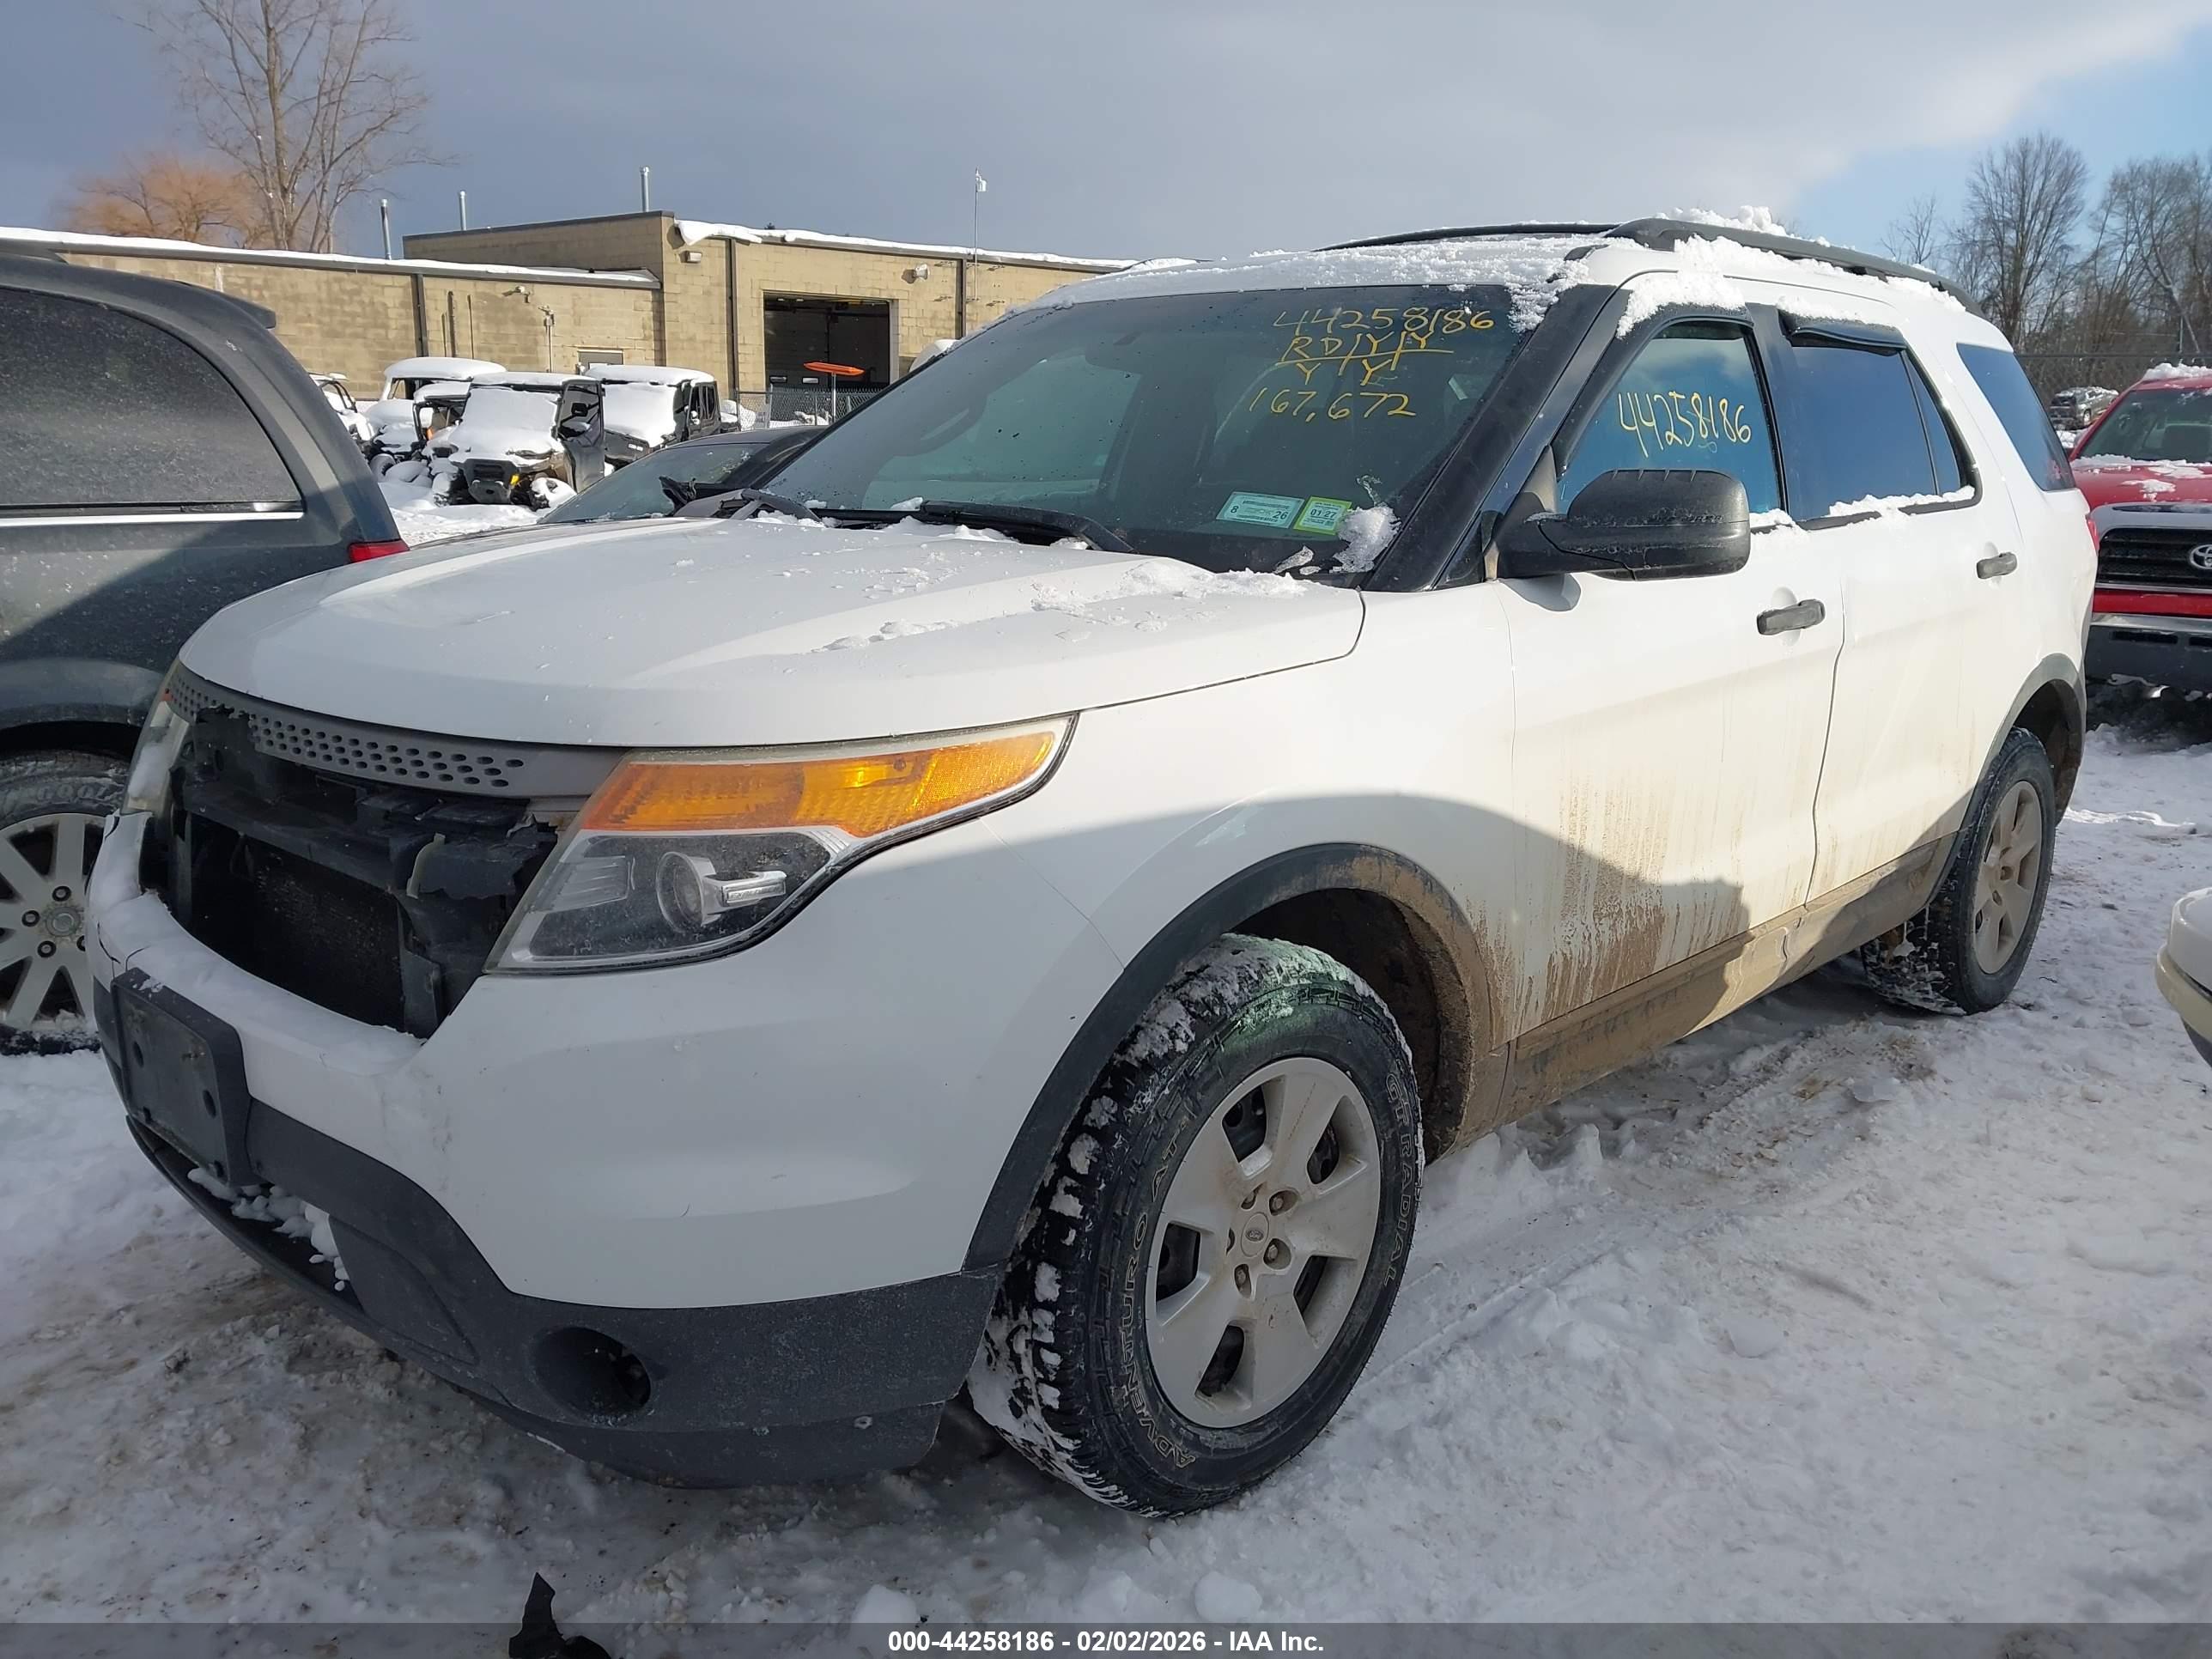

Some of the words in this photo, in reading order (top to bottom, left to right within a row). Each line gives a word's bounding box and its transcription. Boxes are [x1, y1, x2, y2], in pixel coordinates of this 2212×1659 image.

[1273, 307, 1495, 336] 44258186
[1249, 387, 1417, 422] 167,672
[1617, 391, 1752, 458] 44258186
[1231, 505, 1239, 514] 8
[1272, 510, 1289, 520] 26
[1383, 1133, 1413, 1287] RADIAL
